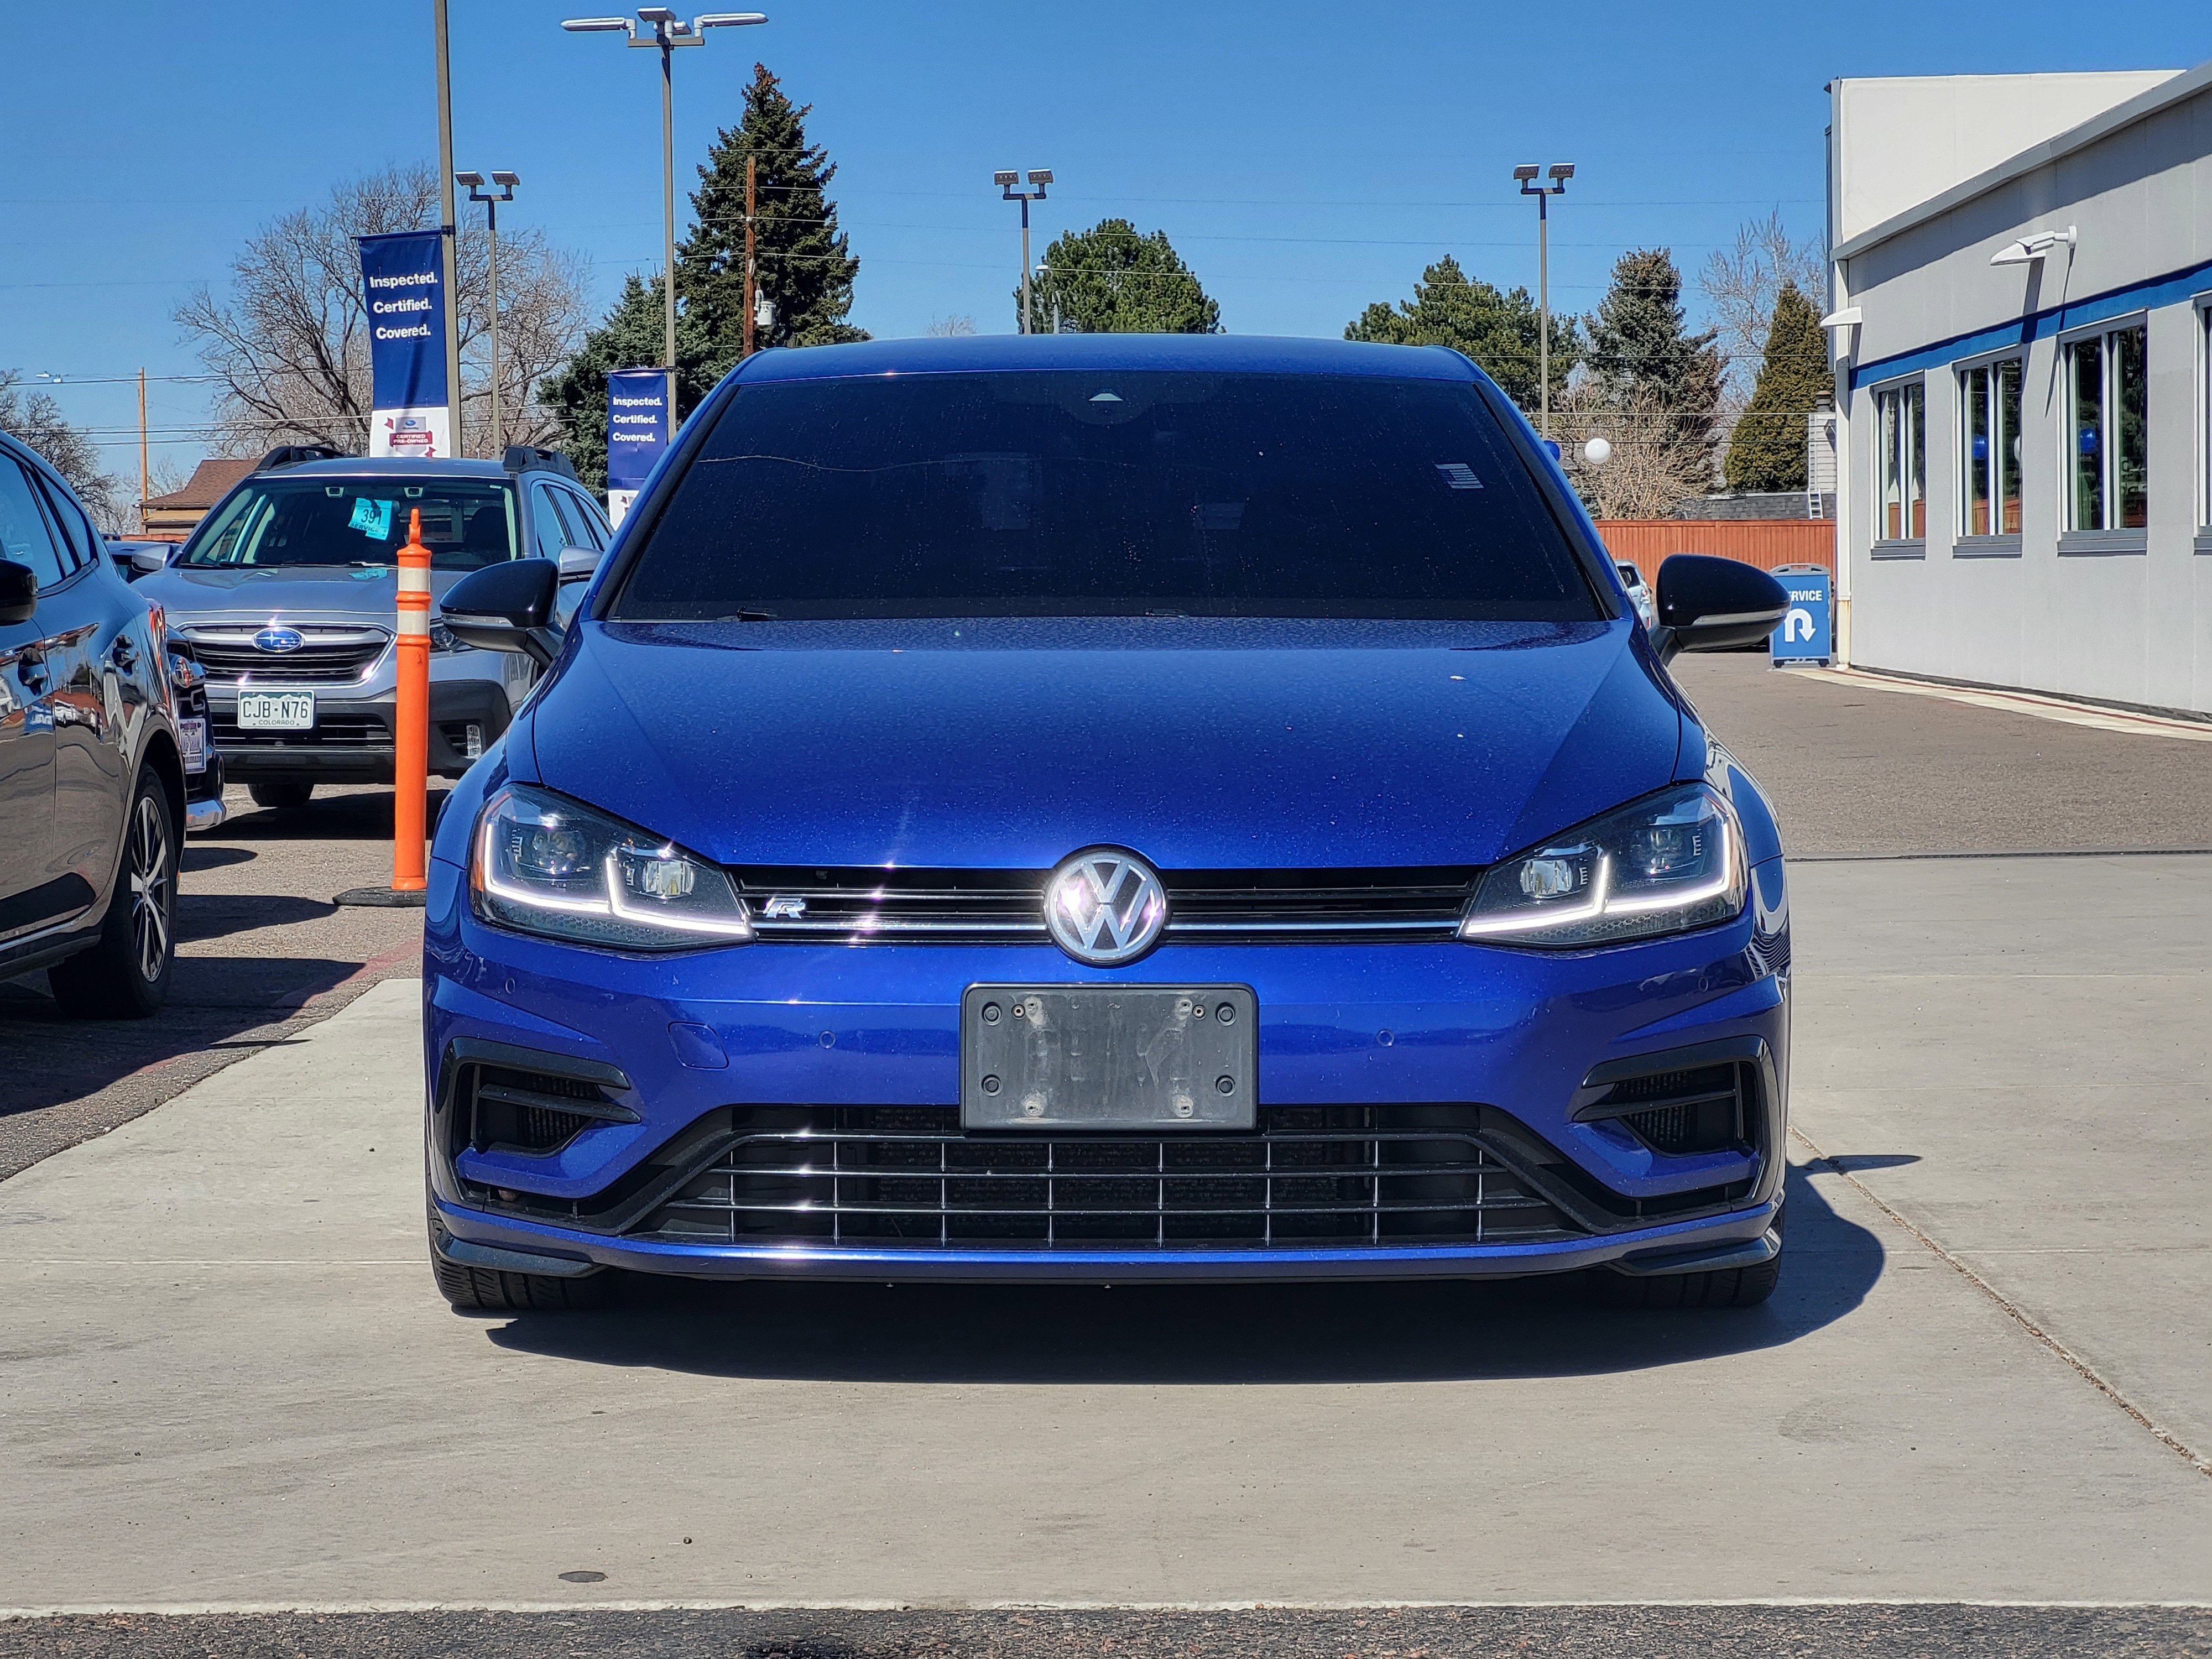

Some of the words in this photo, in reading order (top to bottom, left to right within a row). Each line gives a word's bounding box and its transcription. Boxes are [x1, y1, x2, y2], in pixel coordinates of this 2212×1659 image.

[369, 271, 438, 289] Inspected.
[373, 297, 432, 314] Certified.
[375, 324, 431, 340] Covered.
[613, 397, 662, 408] Inspected.
[613, 415, 658, 424] Certified.
[612, 432, 656, 442] Covered.
[361, 509, 382, 525] 391
[1788, 589, 1823, 602] RVICE
